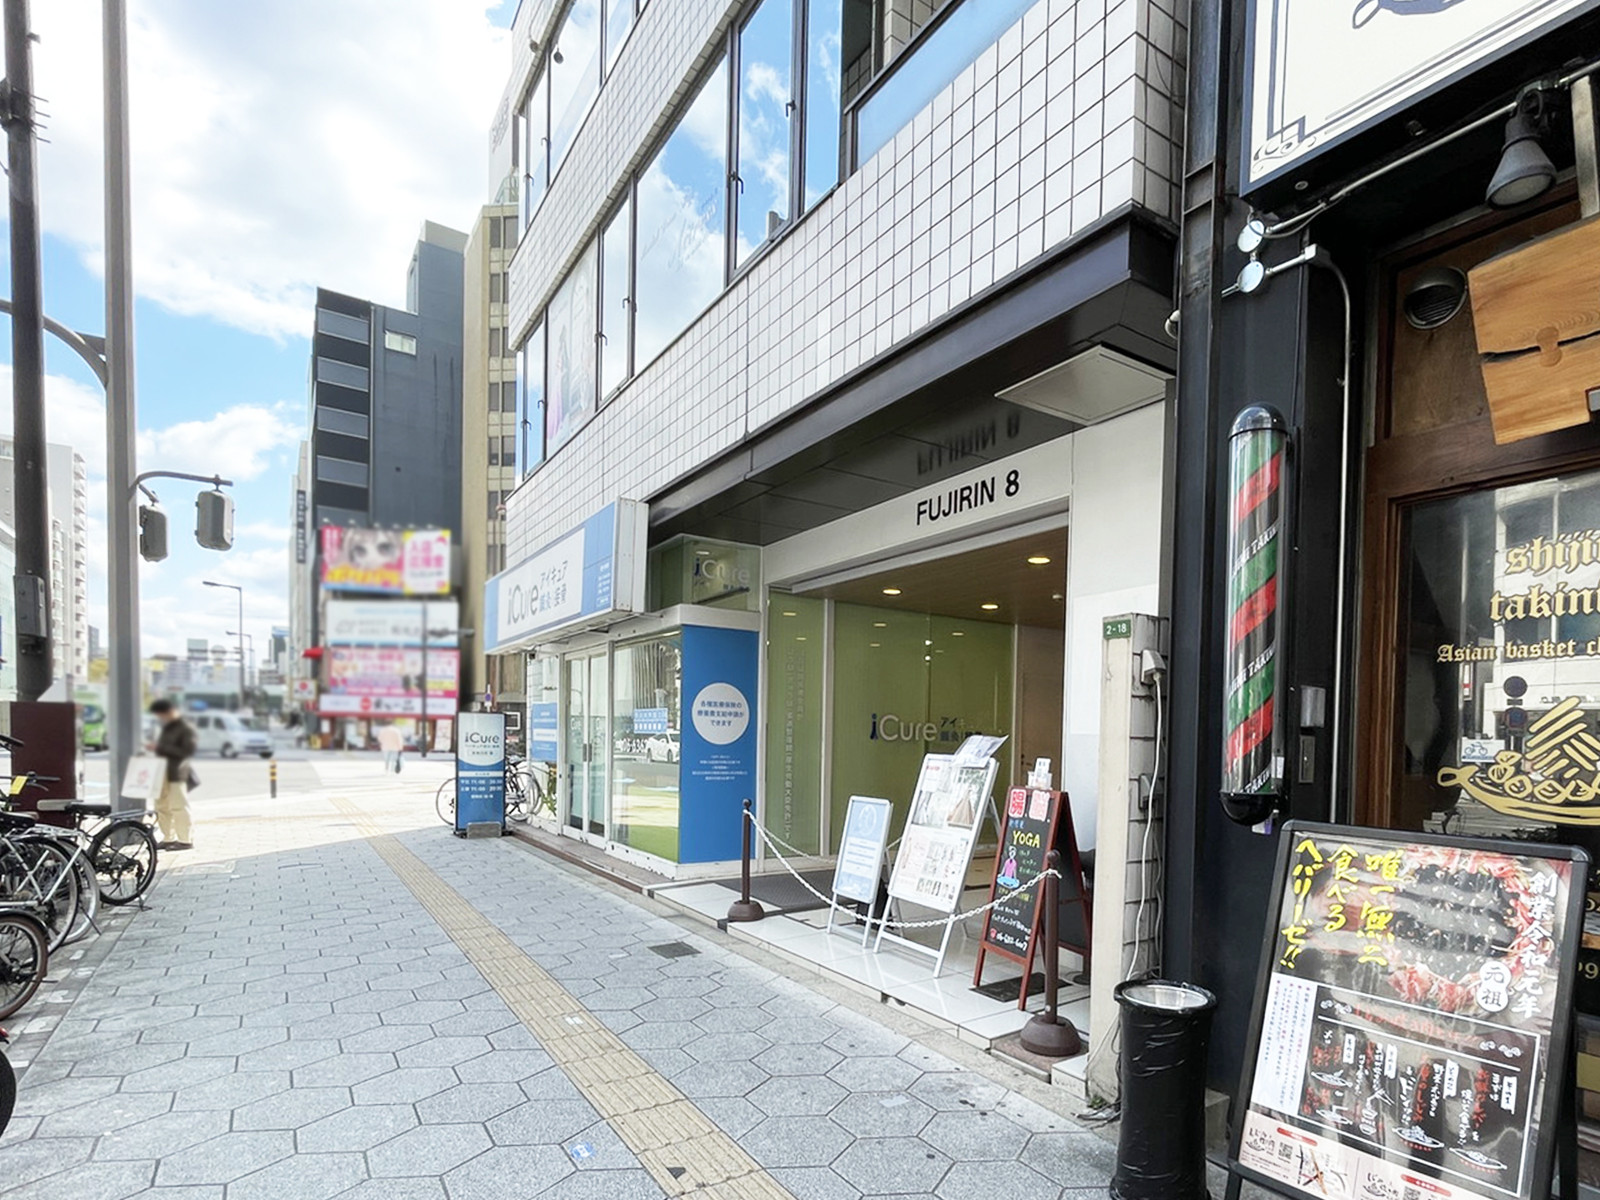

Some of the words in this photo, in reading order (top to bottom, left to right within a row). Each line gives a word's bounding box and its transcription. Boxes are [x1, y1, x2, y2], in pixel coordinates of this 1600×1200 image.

[916, 477, 995, 525] FUJIRIN
[1005, 469, 1020, 497] 8
[507, 584, 539, 625] iCure
[1106, 623, 1127, 635] 2-18
[1437, 643, 1496, 662] Asian
[1505, 638, 1577, 659] basket
[465, 732, 500, 743] iCure
[870, 713, 937, 741] iCure
[1012, 830, 1041, 848] YOGA
[1324, 843, 1359, 932] 食べる
[1356, 849, 1405, 966] 唯一無二
[1511, 872, 1558, 1019] 創業令和元年
[1482, 966, 1505, 1007] 元祖
